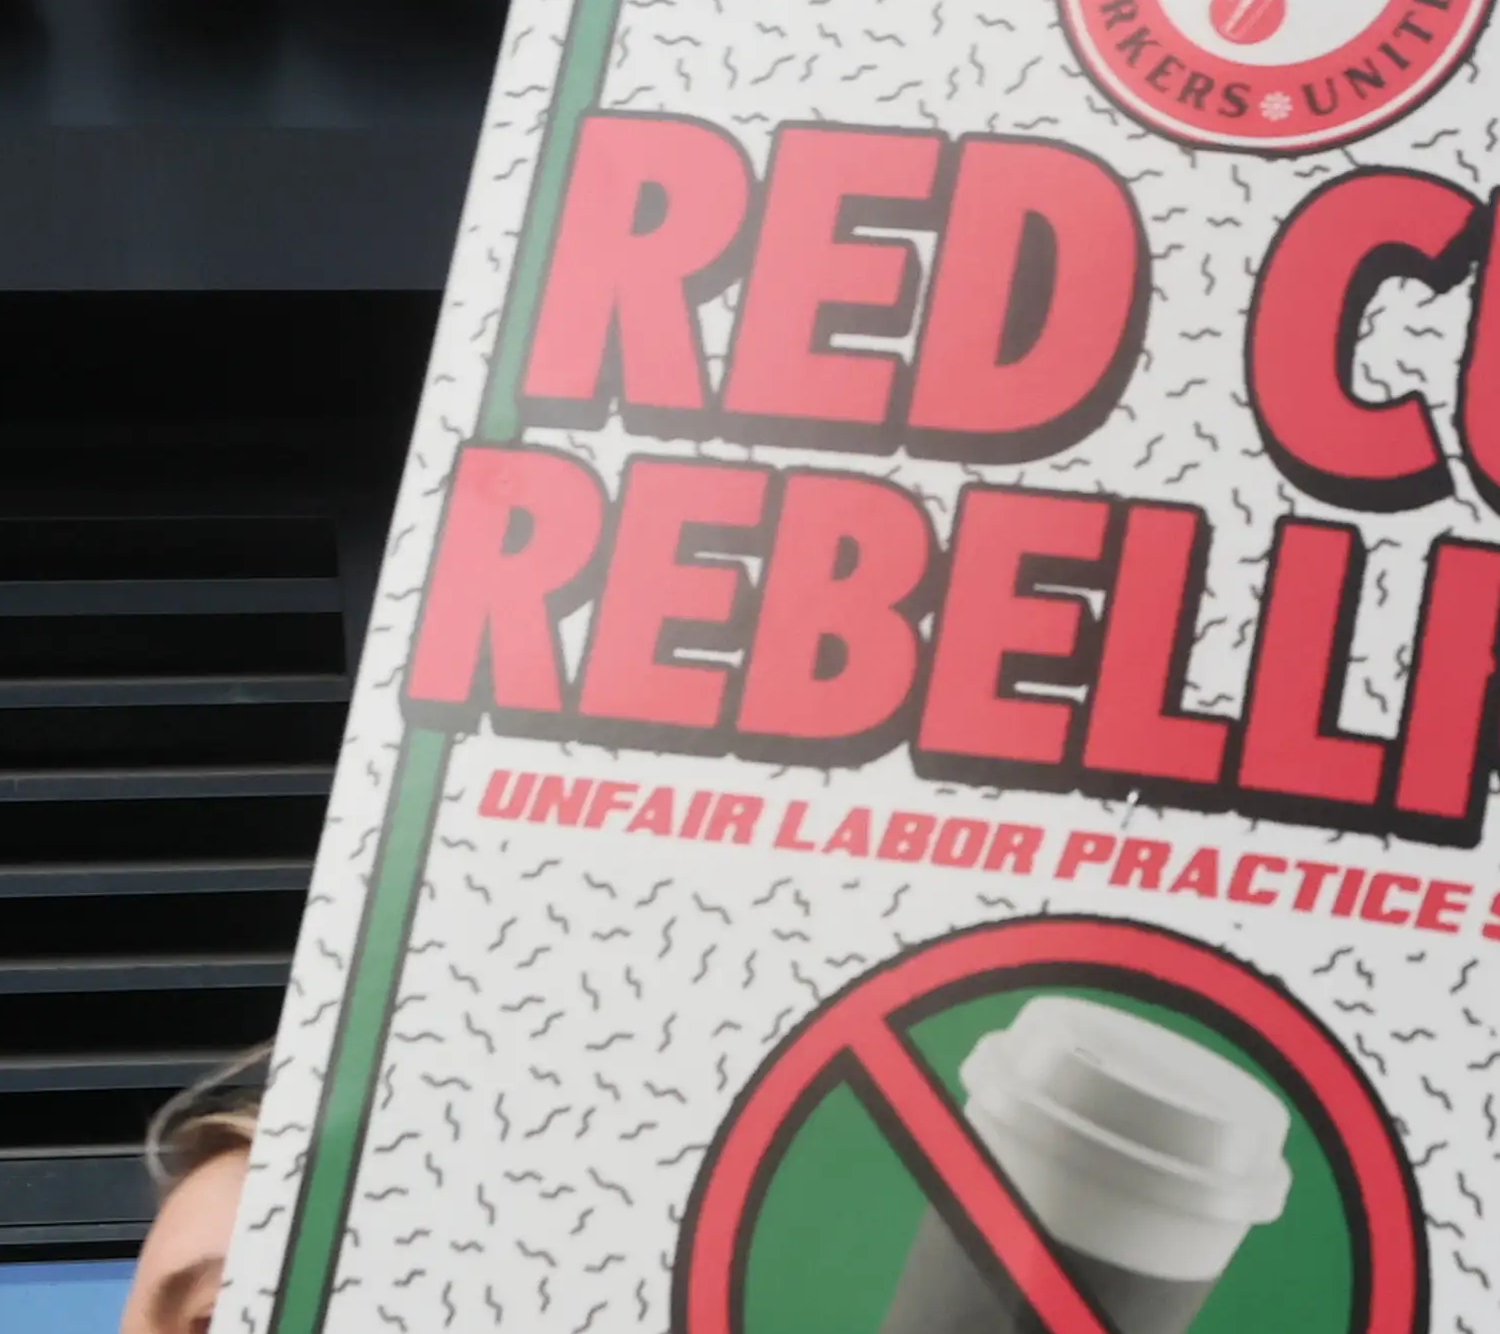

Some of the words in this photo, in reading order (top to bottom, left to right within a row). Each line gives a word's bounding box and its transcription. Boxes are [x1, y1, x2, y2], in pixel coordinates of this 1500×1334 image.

[514, 111, 1152, 465] RED
[477, 768, 765, 846] UNFAIR
[773, 800, 1045, 876] LABOR
[1054, 829, 1473, 935] PRACTICE
